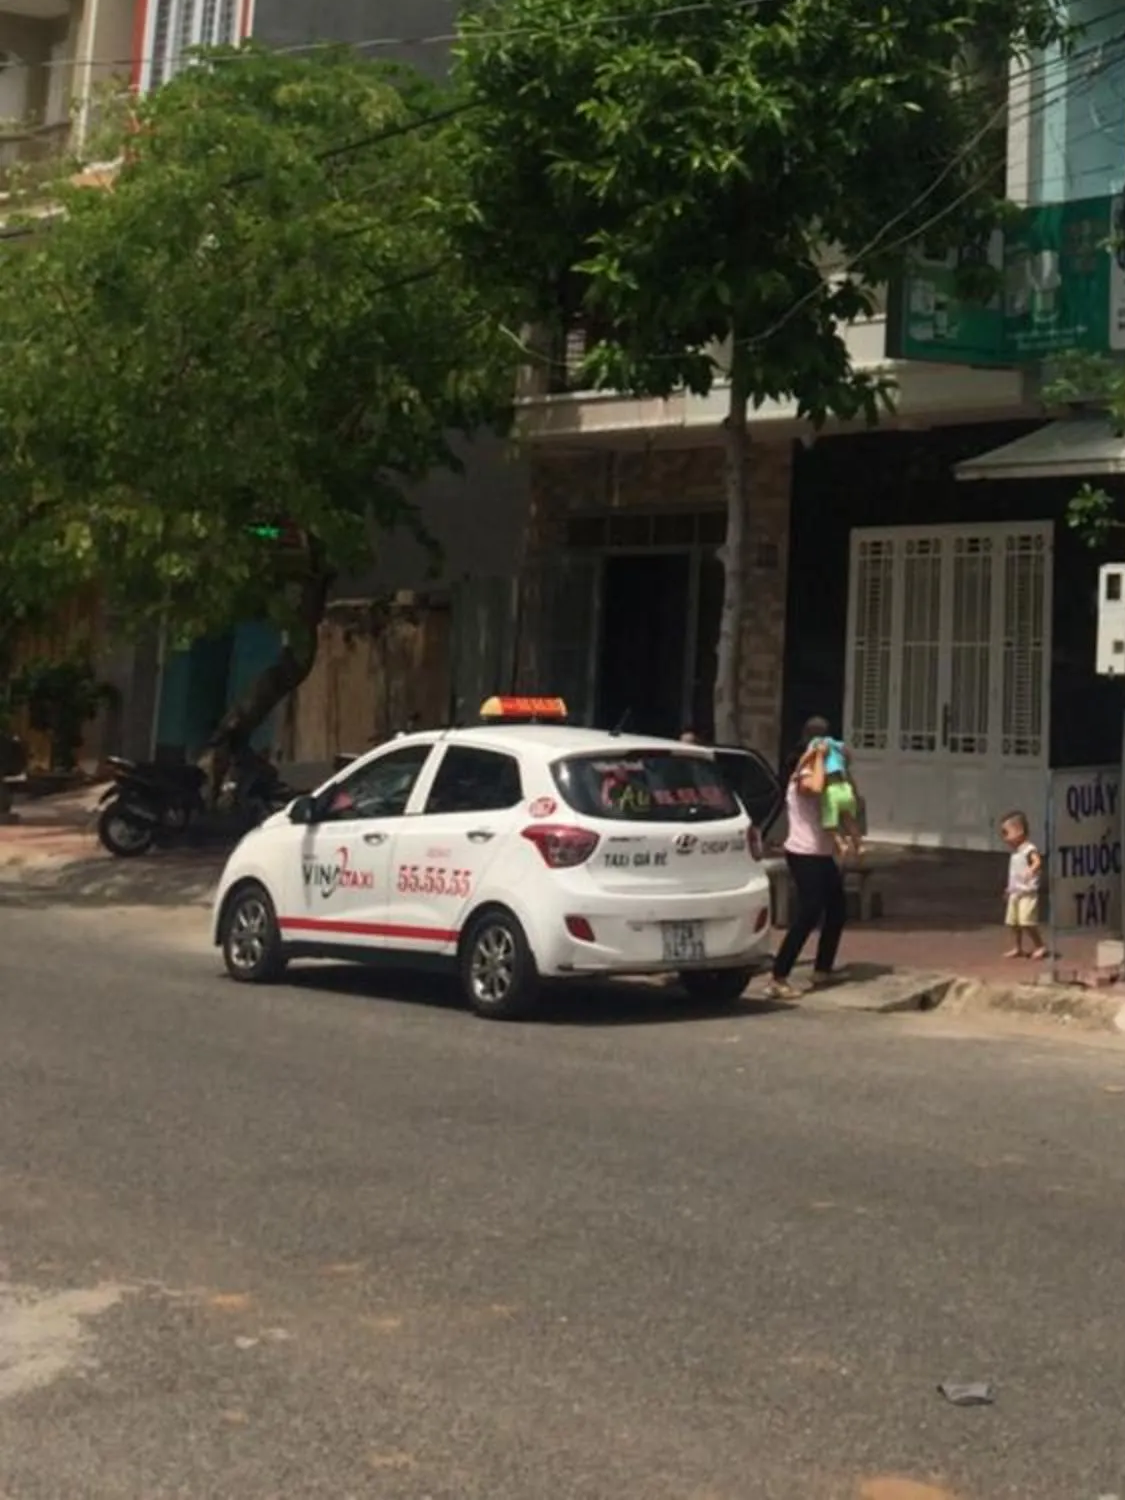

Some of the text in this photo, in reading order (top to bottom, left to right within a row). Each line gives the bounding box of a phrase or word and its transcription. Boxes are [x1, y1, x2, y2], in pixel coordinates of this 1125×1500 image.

[1058, 827, 1122, 879] THUỐC
[397, 864, 474, 898] 55.55.55
[1074, 884, 1111, 927] TÂY
